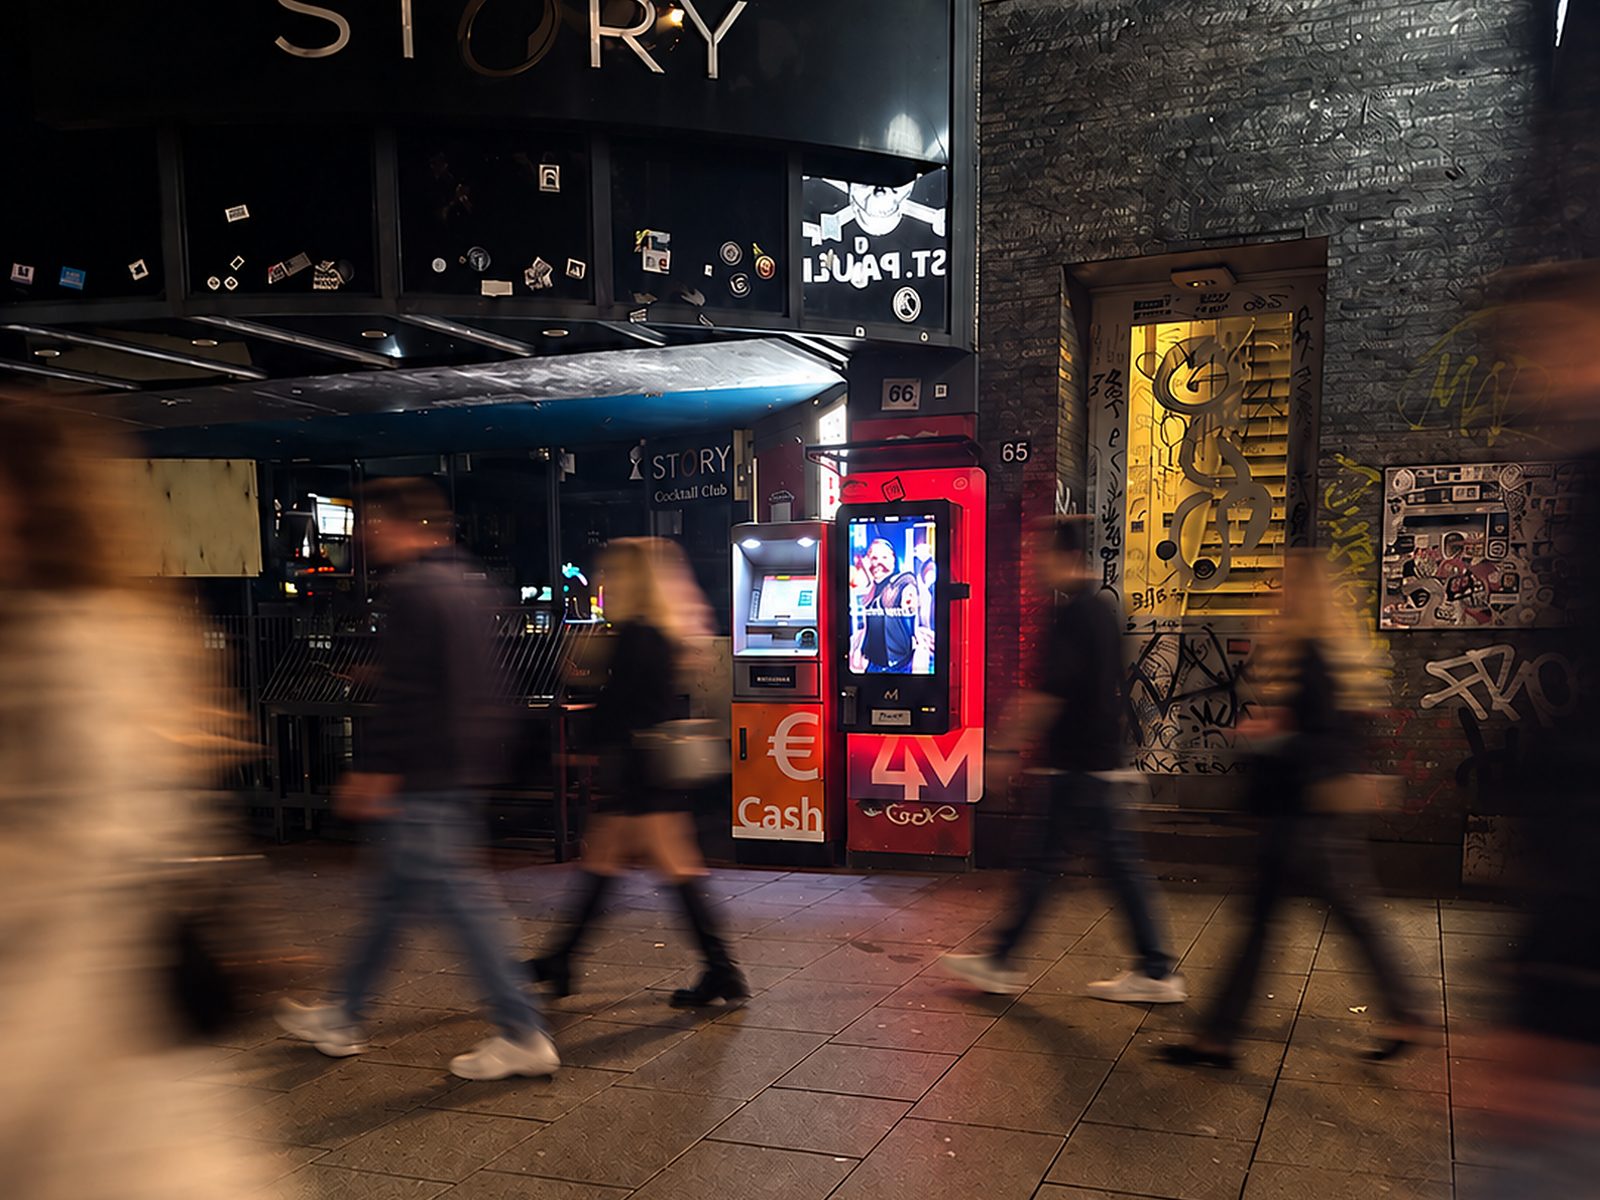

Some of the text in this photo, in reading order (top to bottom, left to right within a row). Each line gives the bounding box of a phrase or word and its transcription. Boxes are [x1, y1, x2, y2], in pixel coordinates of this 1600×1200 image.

[889, 384, 914, 403] 66
[1002, 442, 1028, 462] 65
[653, 445, 731, 480] STORY
[701, 484, 728, 498] Club
[737, 796, 822, 831] Cash
